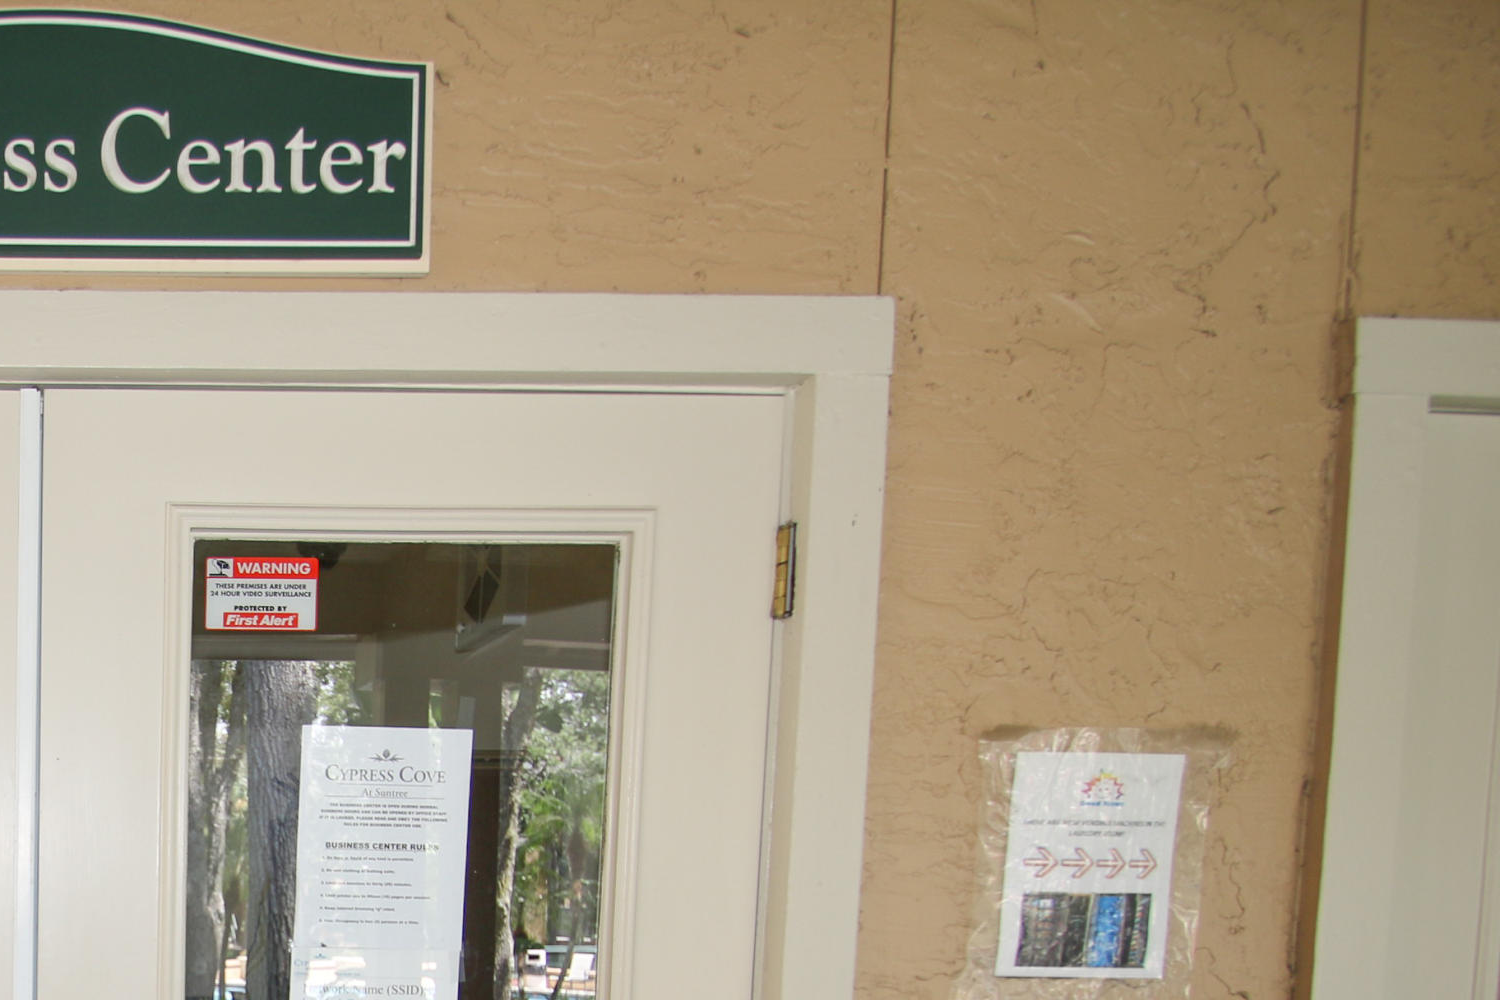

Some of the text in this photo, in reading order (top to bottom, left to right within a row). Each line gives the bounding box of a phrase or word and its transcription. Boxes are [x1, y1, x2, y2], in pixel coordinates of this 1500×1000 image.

[100, 107, 406, 193] Center
[237, 562, 311, 575] WARNING
[226, 614, 294, 626] First Alert
[325, 764, 446, 783] CYPRESS COVE
[363, 788, 408, 798] At Suntree
[325, 842, 370, 850] BUSINESS
[372, 842, 408, 851] CENTER
